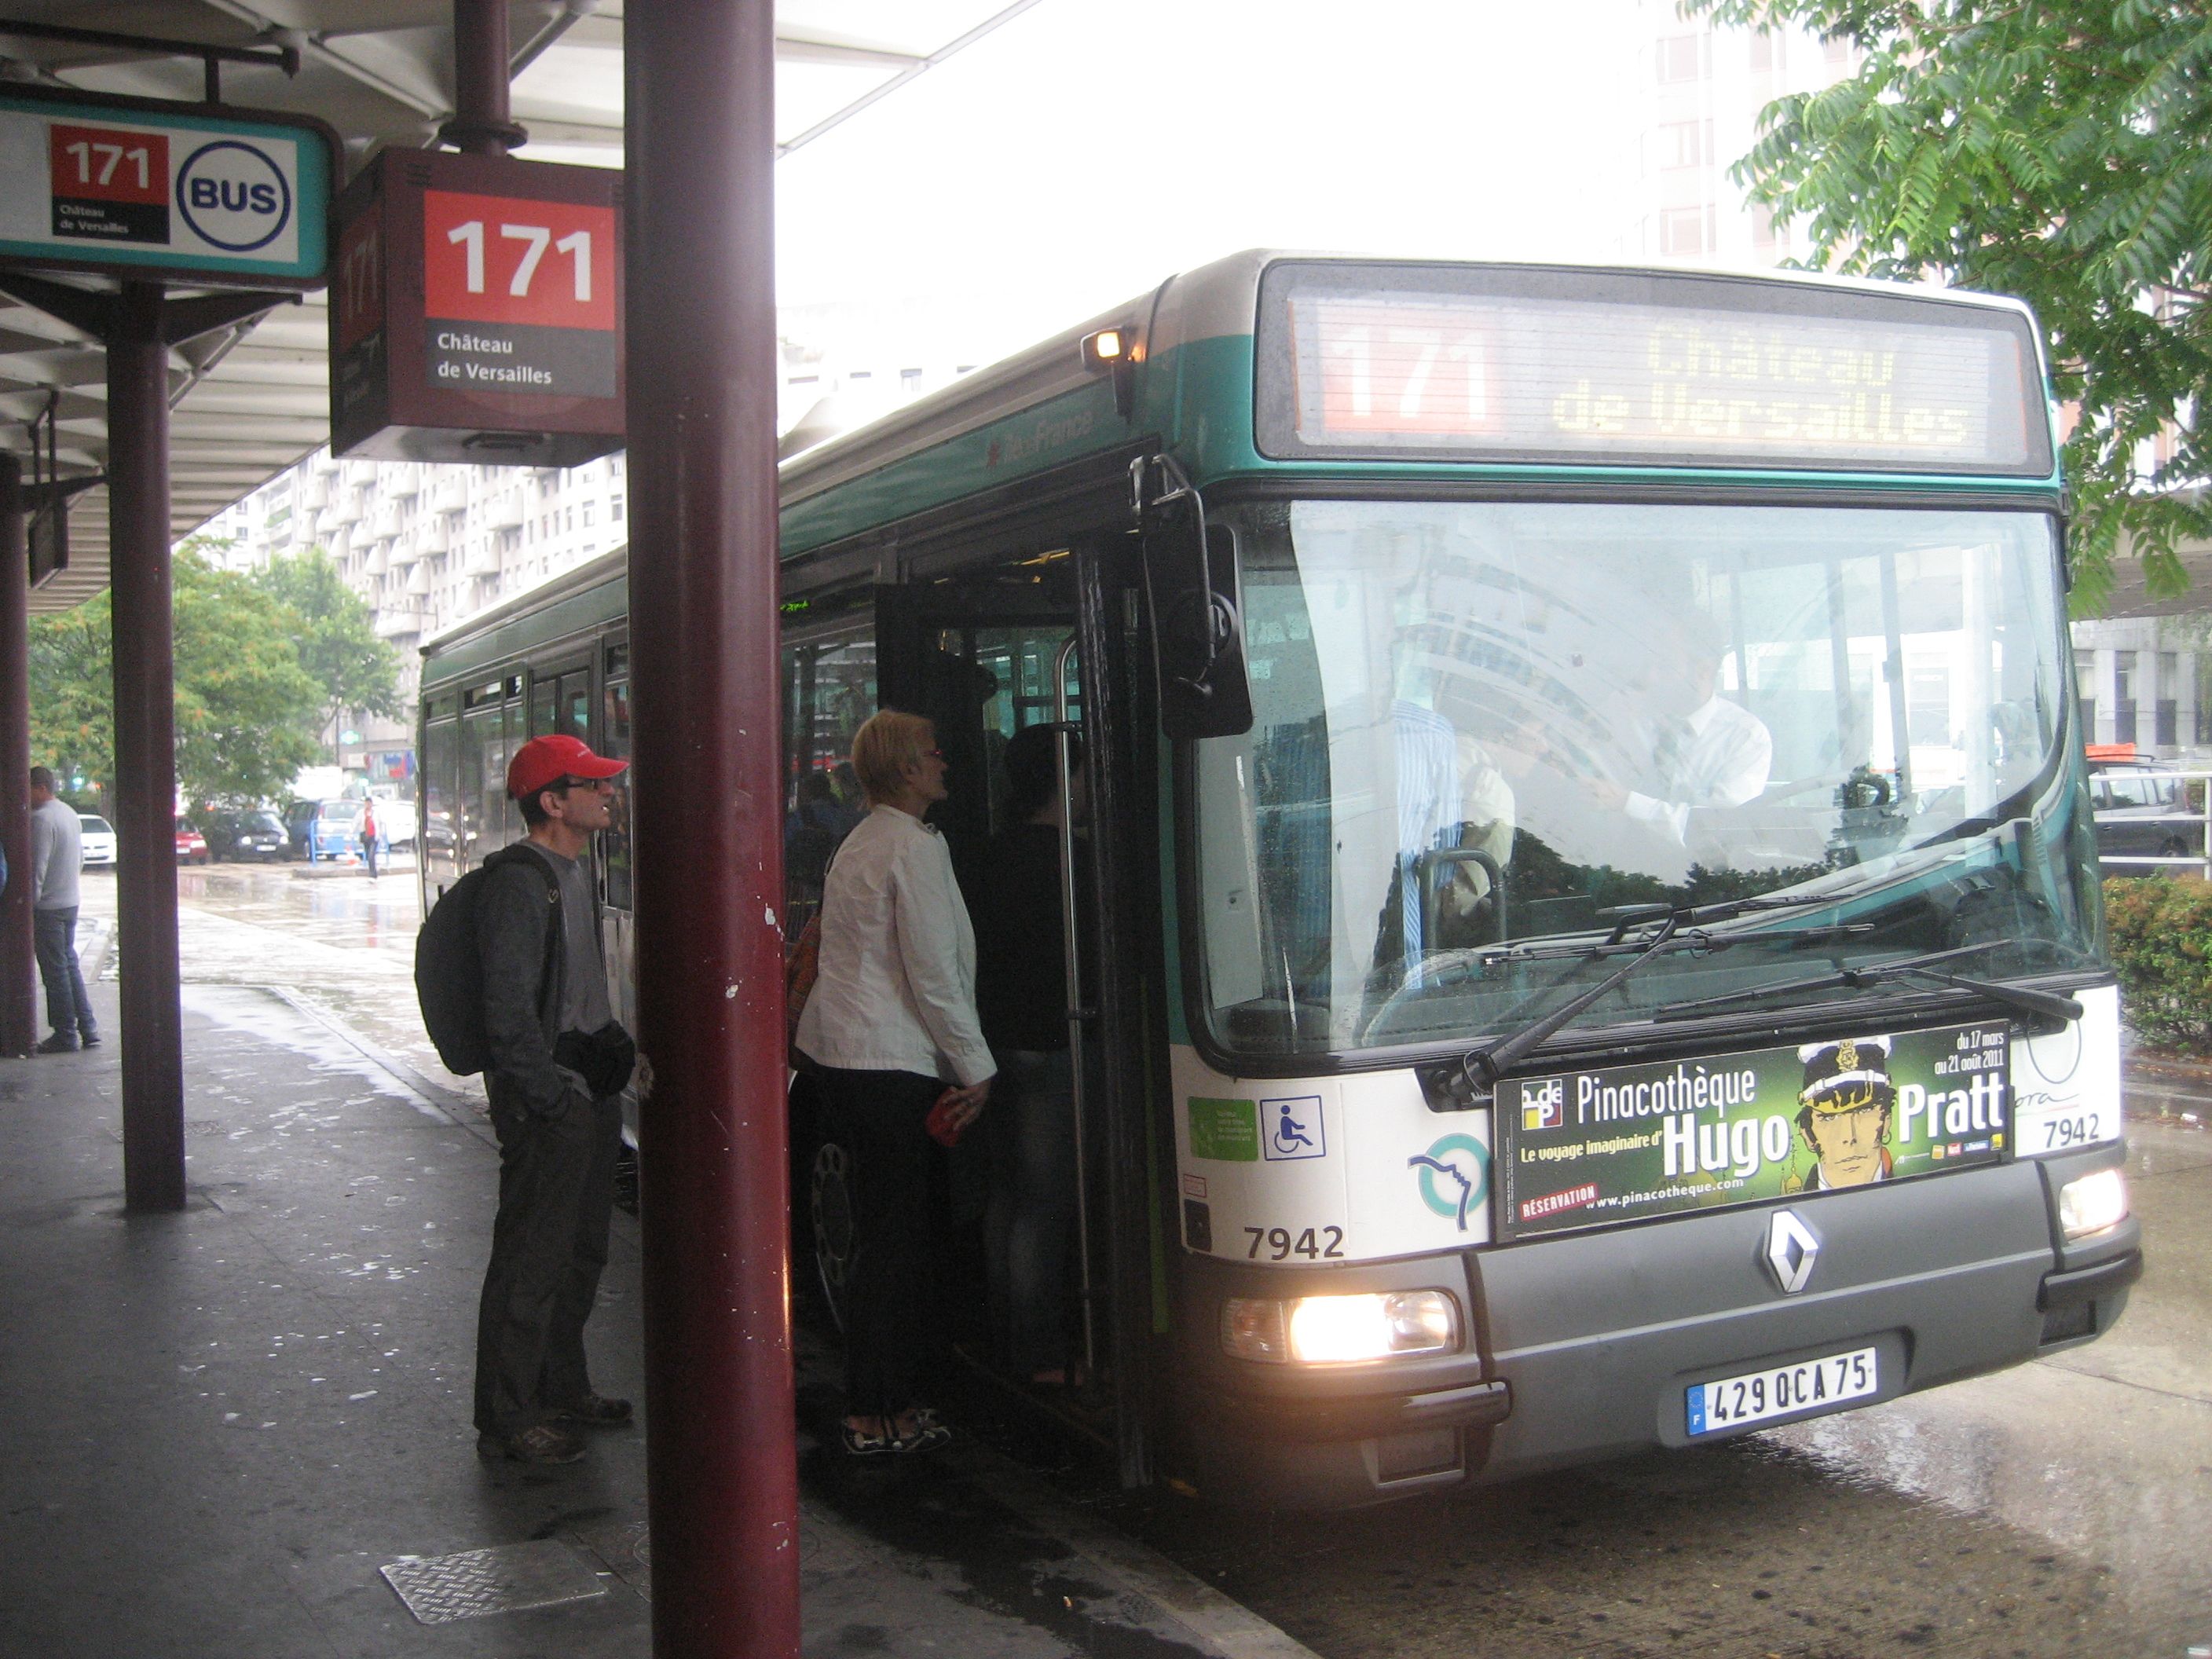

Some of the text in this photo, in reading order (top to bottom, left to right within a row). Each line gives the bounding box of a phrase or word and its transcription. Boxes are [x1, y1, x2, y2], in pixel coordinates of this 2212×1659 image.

[67, 141, 149, 189] 171
[60, 204, 104, 218] Château
[191, 178, 276, 214] BUS
[60, 218, 129, 234] de Versailles
[447, 221, 591, 302] 171
[438, 333, 512, 353] Château
[438, 361, 552, 384] de Versailles
[1330, 325, 1487, 419] 171
[1553, 379, 1968, 442] de Versailles
[1957, 1030, 2004, 1049] du 17 mars
[1935, 1049, 2004, 1075] au 21 août 2011
[1577, 1064, 1756, 1124] Pinacothèque
[1663, 1072, 2004, 1177] Hugo Pratt
[2044, 1112, 2100, 1149] 7942
[1521, 1130, 1662, 1163] Le voyage imaginaire d'
[1522, 1185, 1595, 1218] RÉSERVATION
[1585, 1178, 1744, 1210] www.pinacotheque.com
[1244, 1225, 1344, 1261] 7942
[1714, 1353, 1866, 1421] 429 QCA 75
[1693, 1415, 1701, 1426] F
